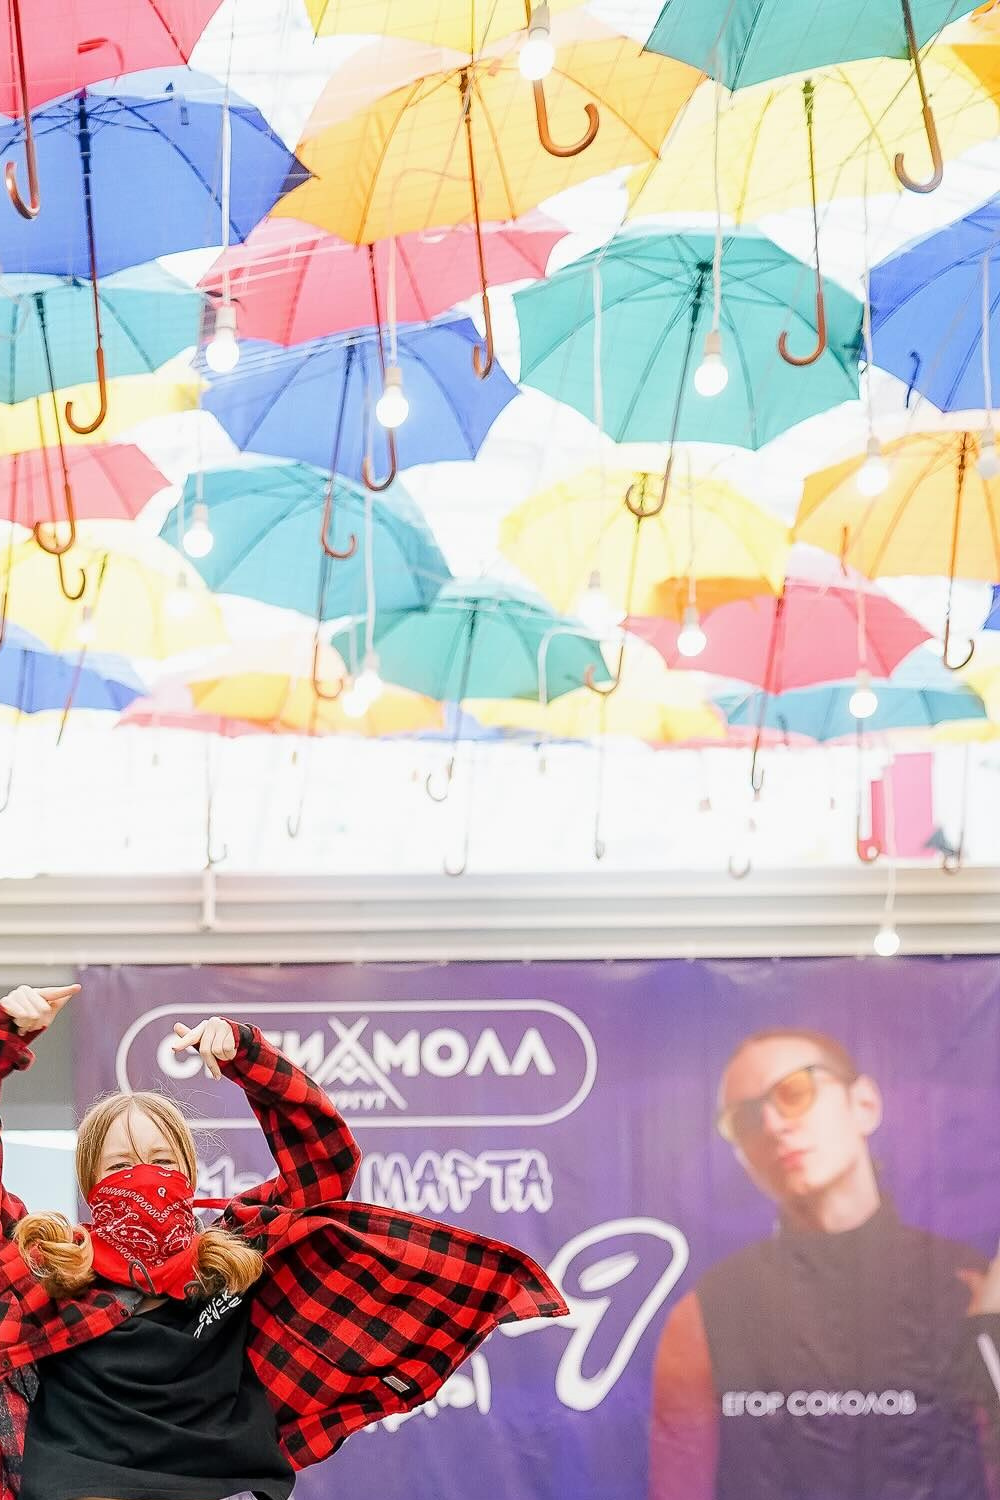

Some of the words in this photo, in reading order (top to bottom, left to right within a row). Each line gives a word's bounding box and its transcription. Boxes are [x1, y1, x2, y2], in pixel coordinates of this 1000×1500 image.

[156, 1028, 325, 1080] СИ
[372, 1026, 556, 1079] МОЛЛ
[359, 1149, 554, 1214] МАРТА
[722, 1391, 785, 1417] ЕГОР
[786, 1389, 917, 1417] СОКОЛОВ
